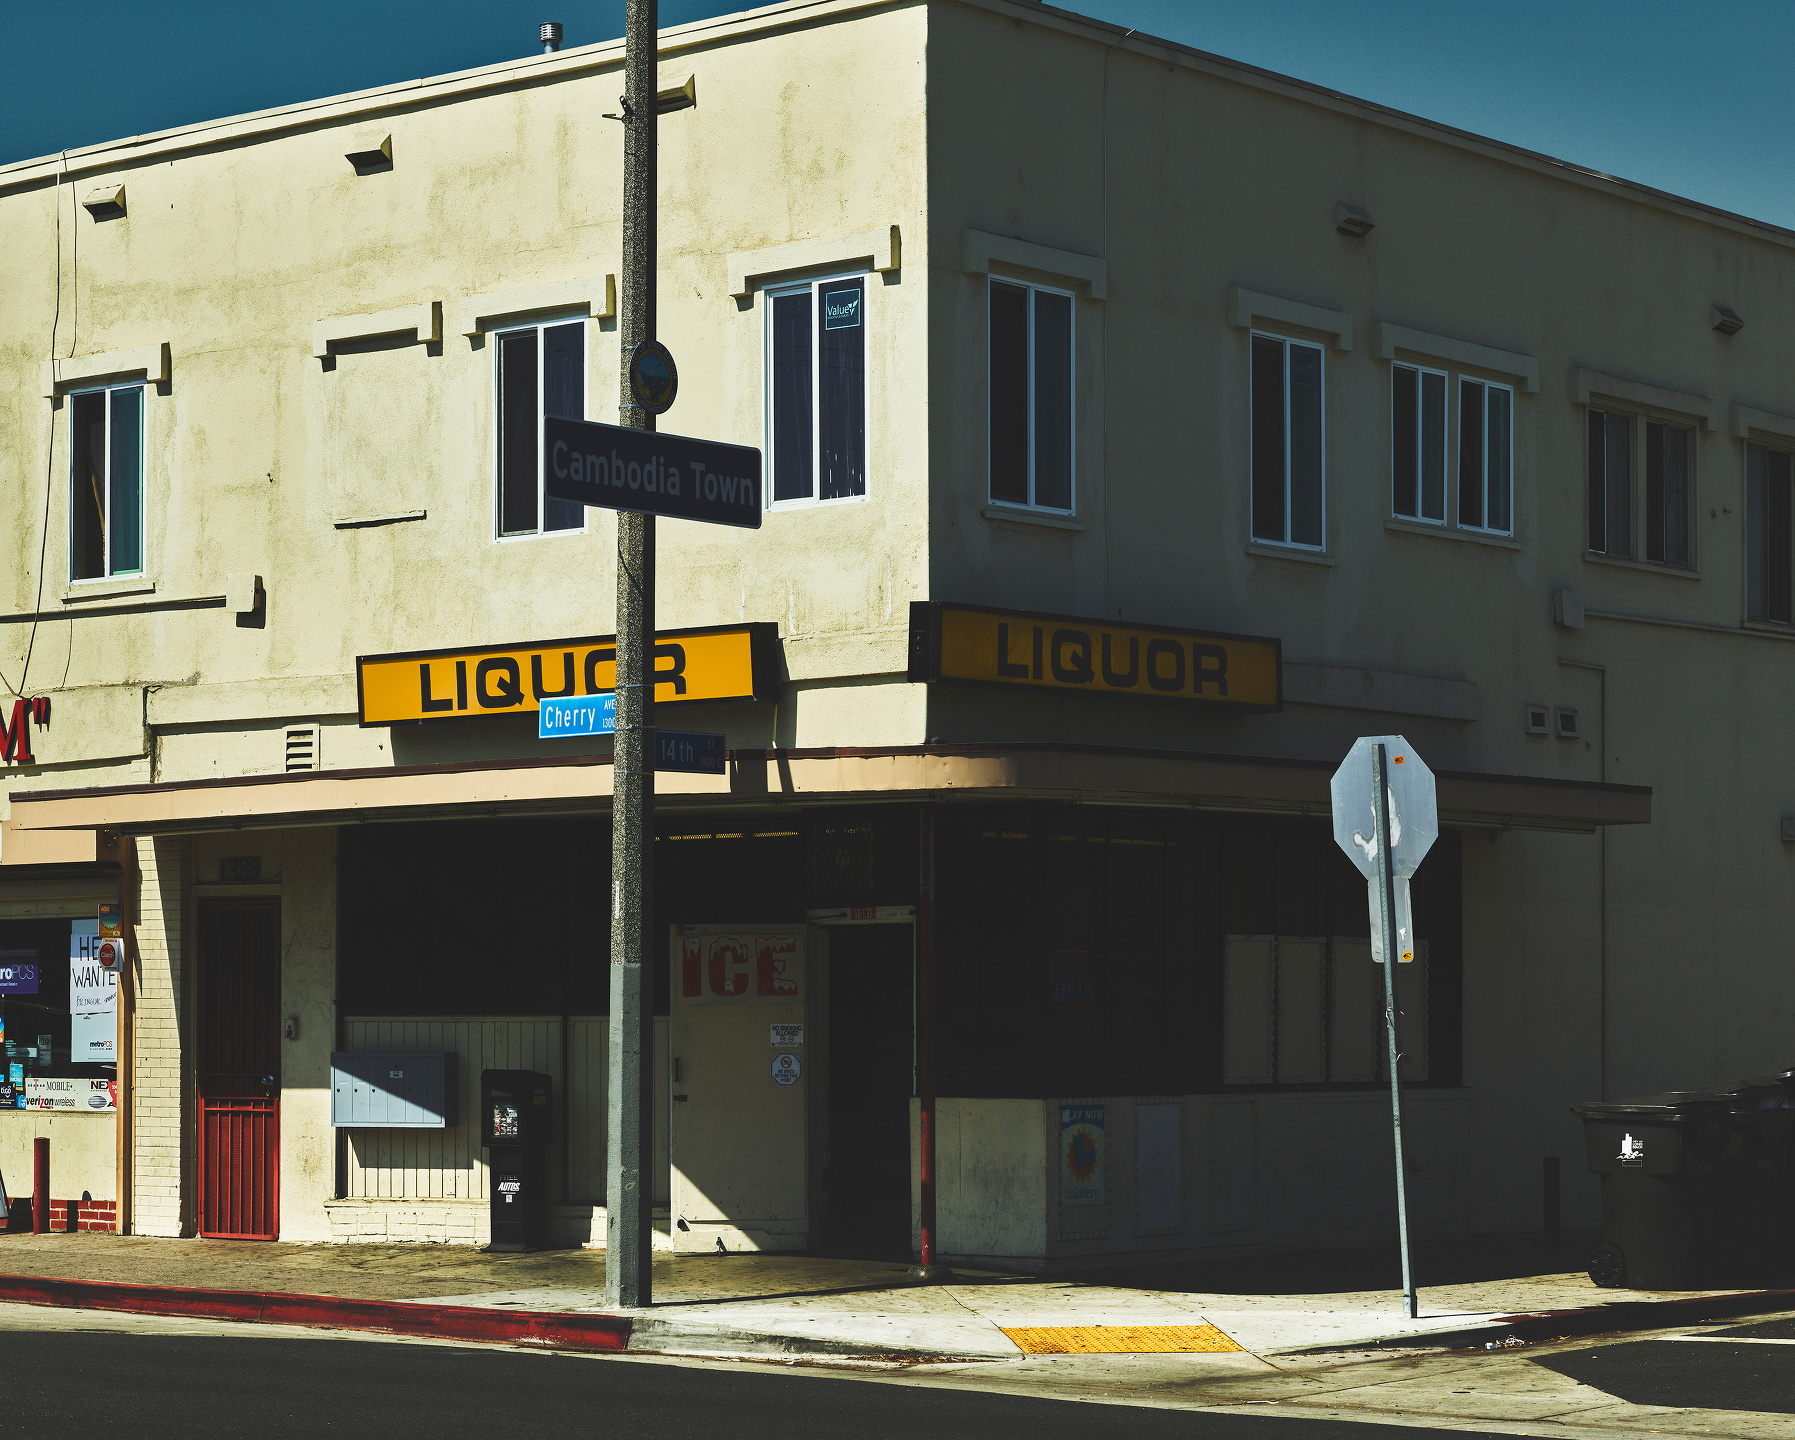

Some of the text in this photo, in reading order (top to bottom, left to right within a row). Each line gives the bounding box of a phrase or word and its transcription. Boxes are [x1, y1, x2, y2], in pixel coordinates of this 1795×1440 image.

[552, 440, 754, 507] Cambodia Town
[997, 622, 1228, 697] LIQUOR
[545, 705, 596, 731] Cherry
[661, 738, 715, 763] 14th ST
[682, 936, 798, 997] ICE
[26, 1095, 54, 1108] verizon
[54, 1097, 75, 1107] wireless
[1085, 1109, 1103, 1120] NOW
[497, 1182, 521, 1192] AUTOS
[1065, 1185, 1099, 1201] calottery
